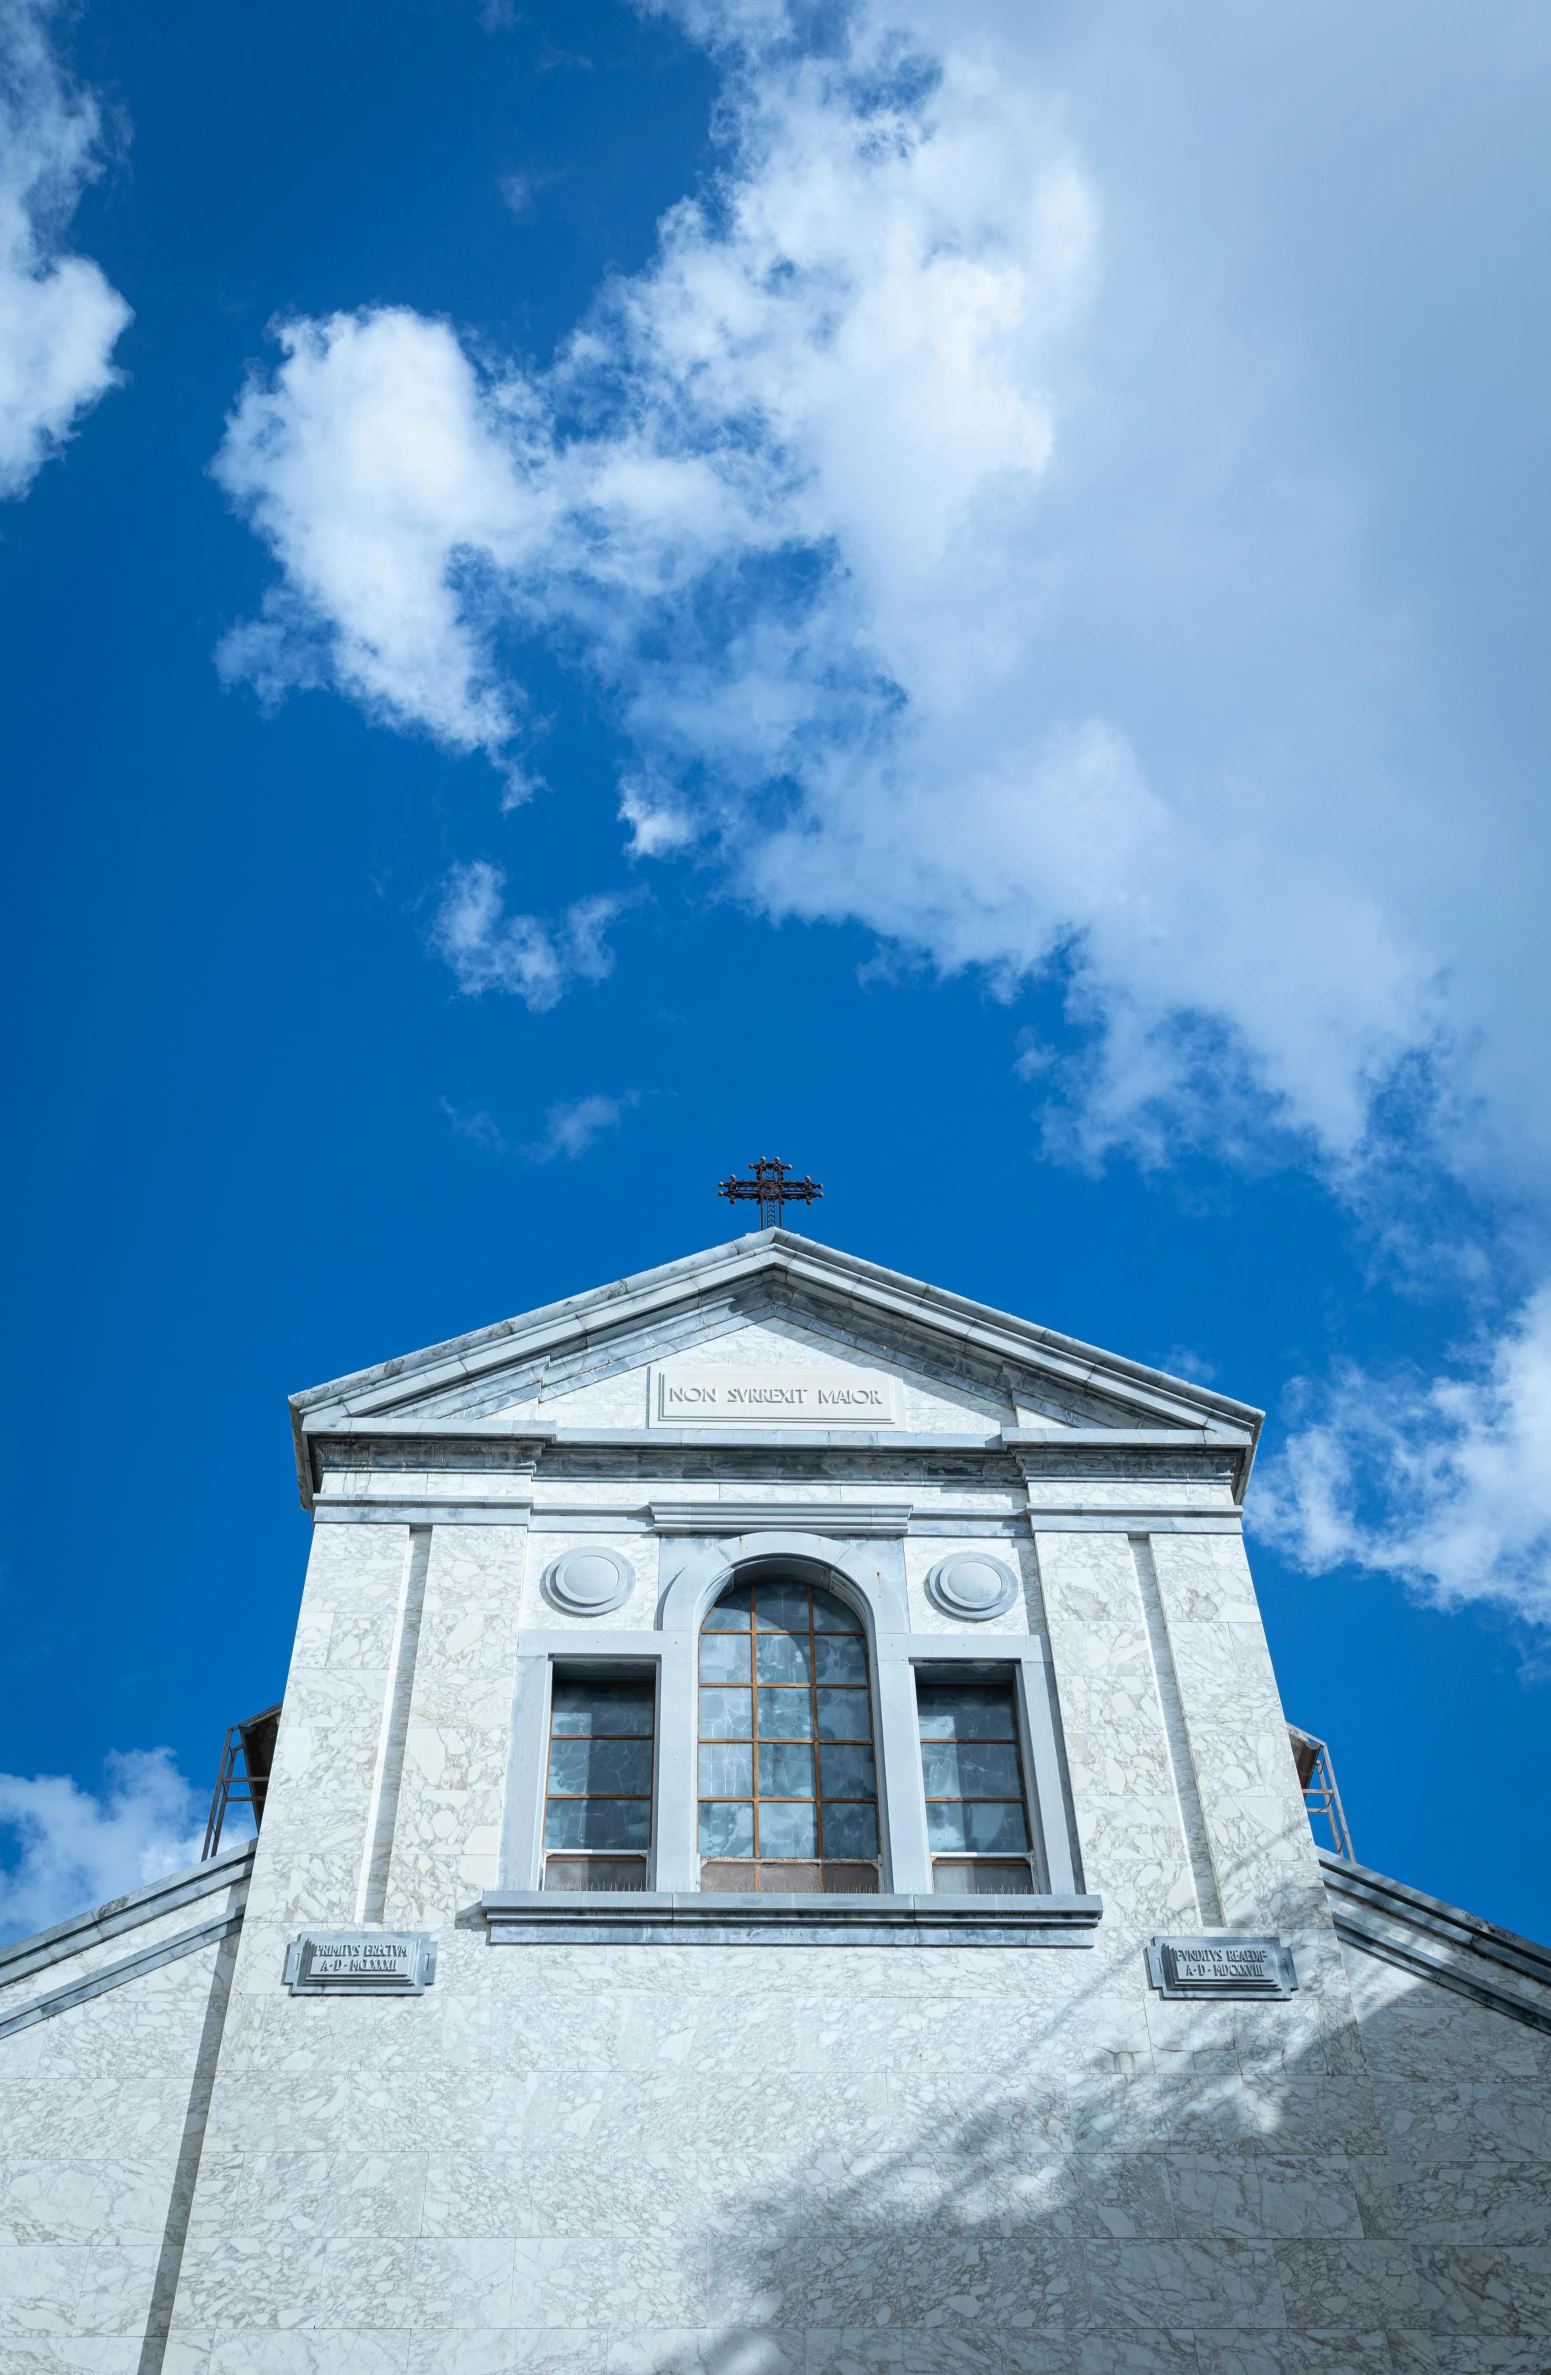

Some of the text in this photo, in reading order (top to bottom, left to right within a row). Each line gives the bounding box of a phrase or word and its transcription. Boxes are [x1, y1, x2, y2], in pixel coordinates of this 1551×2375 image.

[669, 1387, 883, 1405] NON SVRREXIT MAIOR
[314, 1944, 408, 1957] PRIMITVS ERECTVM
[1175, 1949, 1223, 1962] FVNDITVS
